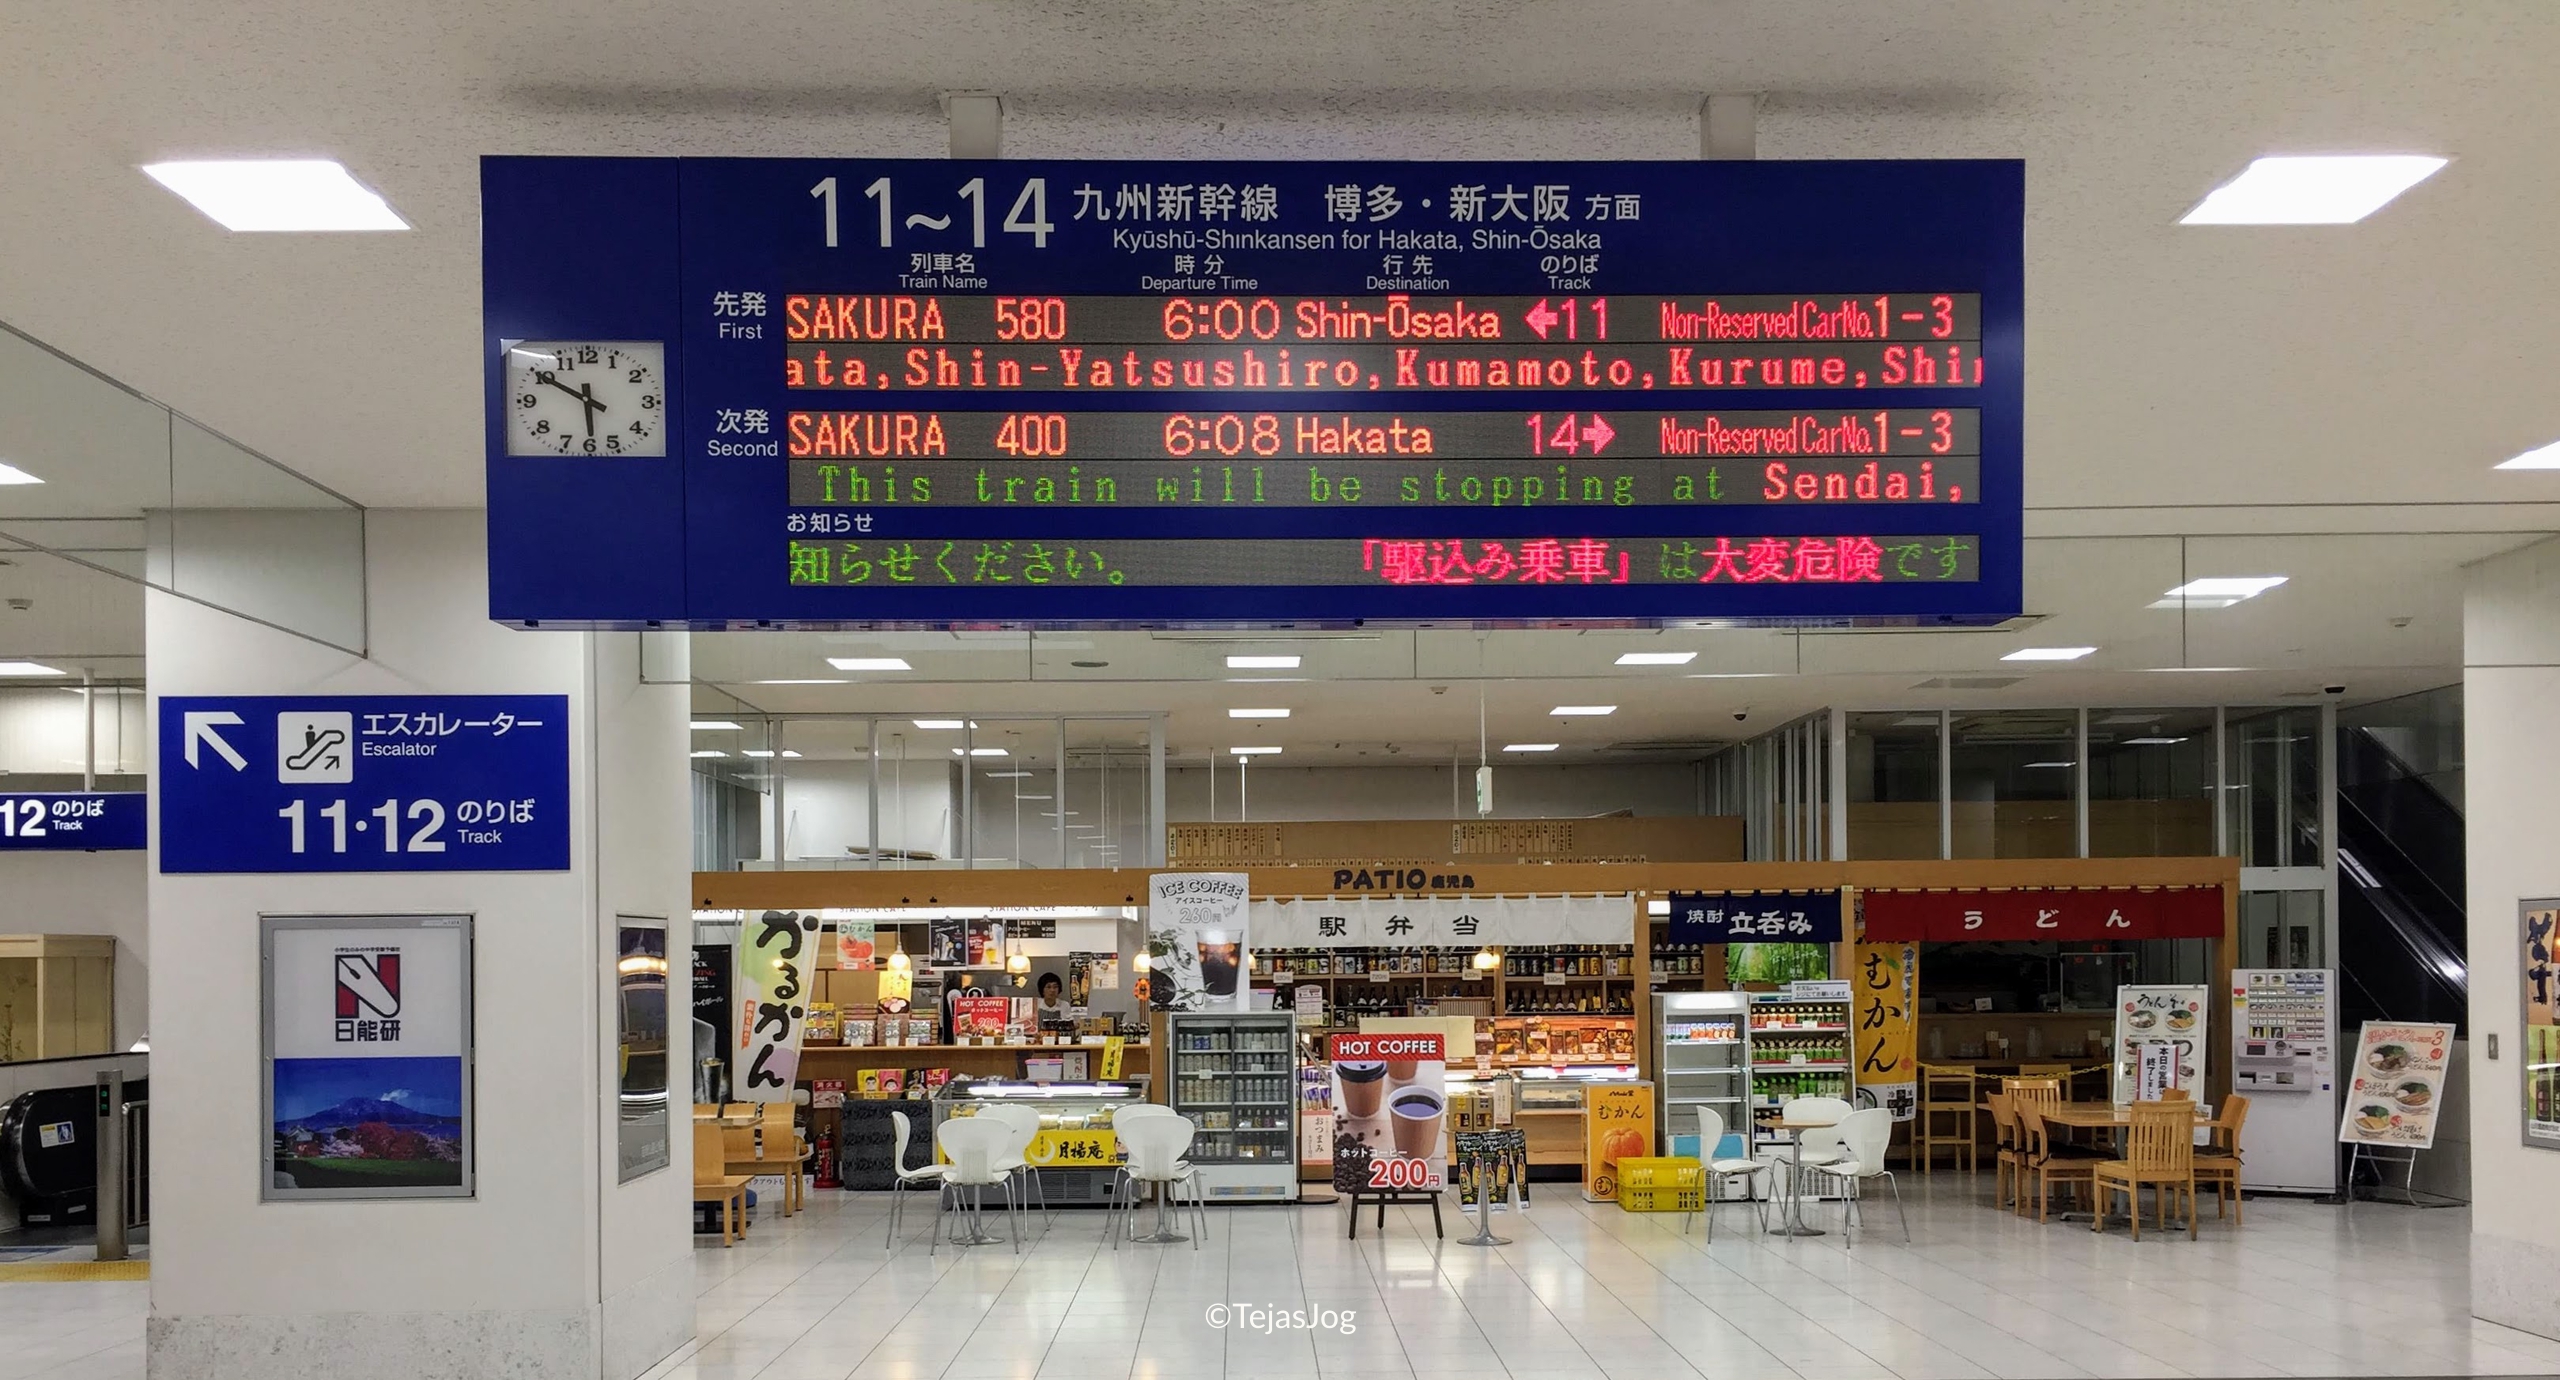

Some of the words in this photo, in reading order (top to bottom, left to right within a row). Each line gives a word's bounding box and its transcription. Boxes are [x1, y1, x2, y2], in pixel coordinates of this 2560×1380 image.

[1073, 183, 1279, 222] 九州新幹線
[1324, 184, 1571, 223] 博多・新大阪
[1585, 193, 1641, 222] 方面
[1342, 229, 1371, 250] for
[1378, 229, 1464, 253] Hakata,
[1472, 225, 1602, 250] Shin-Ōsaka
[910, 252, 976, 274] 列車名
[1540, 254, 1600, 275] のりば
[899, 275, 938, 290] Train
[942, 275, 988, 290] Name
[1141, 276, 1216, 292] Departure
[1220, 276, 1258, 290] Time
[1366, 276, 1450, 290] Destination
[1547, 276, 1592, 290] Track
[713, 291, 767, 318] 先発
[787, 297, 945, 340] SAKURA
[996, 298, 1066, 341] 580
[1164, 298, 1280, 341] 6:00
[1296, 295, 1501, 340] Shin-Ōsaka
[1561, 298, 1608, 340] 11
[719, 323, 763, 340] First
[557, 357, 574, 371] 11
[578, 350, 598, 364] 12
[608, 355, 617, 369] 1
[535, 371, 555, 384] 10
[628, 369, 642, 383] 2
[523, 394, 537, 408] 9
[641, 395, 655, 409] 3
[536, 420, 550, 434] 8
[629, 420, 643, 434] 4
[715, 408, 770, 435] 次発
[559, 434, 573, 449] 7
[606, 435, 620, 449] 5
[788, 414, 946, 456] SAKURA
[996, 414, 1067, 456] 400
[1164, 414, 1281, 456] 6:08
[1297, 416, 1434, 454] Hakata
[1525, 412, 1580, 455] 14
[582, 438, 597, 452] 6
[707, 440, 779, 458] Second
[817, 466, 932, 502] This
[975, 466, 1117, 502] train
[1156, 465, 1266, 502] will
[1309, 465, 1363, 502] be
[1400, 464, 1635, 507] stopping
[1673, 466, 1725, 501] at
[1763, 461, 1962, 503] Sendai,
[786, 512, 873, 534] お知らせ
[788, 540, 1125, 585] 知らせください。
[362, 712, 543, 736] エスカレーター
[361, 742, 437, 756] Escalator
[51, 799, 105, 817] のりば
[456, 798, 536, 824] のりば
[52, 820, 83, 831] Track
[457, 829, 503, 844] Track
[1333, 869, 1427, 891] PATIO
[1430, 874, 1476, 889] 鹿児島
[1158, 880, 1185, 899] ICE
[1188, 878, 1245, 900] COFFEE
[1179, 907, 1222, 924] 260円
[1686, 909, 1725, 923] 焼酎
[1728, 910, 1813, 935] 立呑み
[1862, 952, 1902, 1073] むかん
[335, 1020, 401, 1041] 日能研
[1338, 1040, 1372, 1055] HOT
[1377, 1039, 1437, 1054] COFFEE
[1597, 1104, 1646, 1120] むかん
[1314, 1116, 1325, 1153] おつまみ
[1058, 1140, 1105, 1160] 月揚庵
[1340, 1148, 1408, 1159] ホットコーヒー
[1368, 1157, 1441, 1188] 200円
